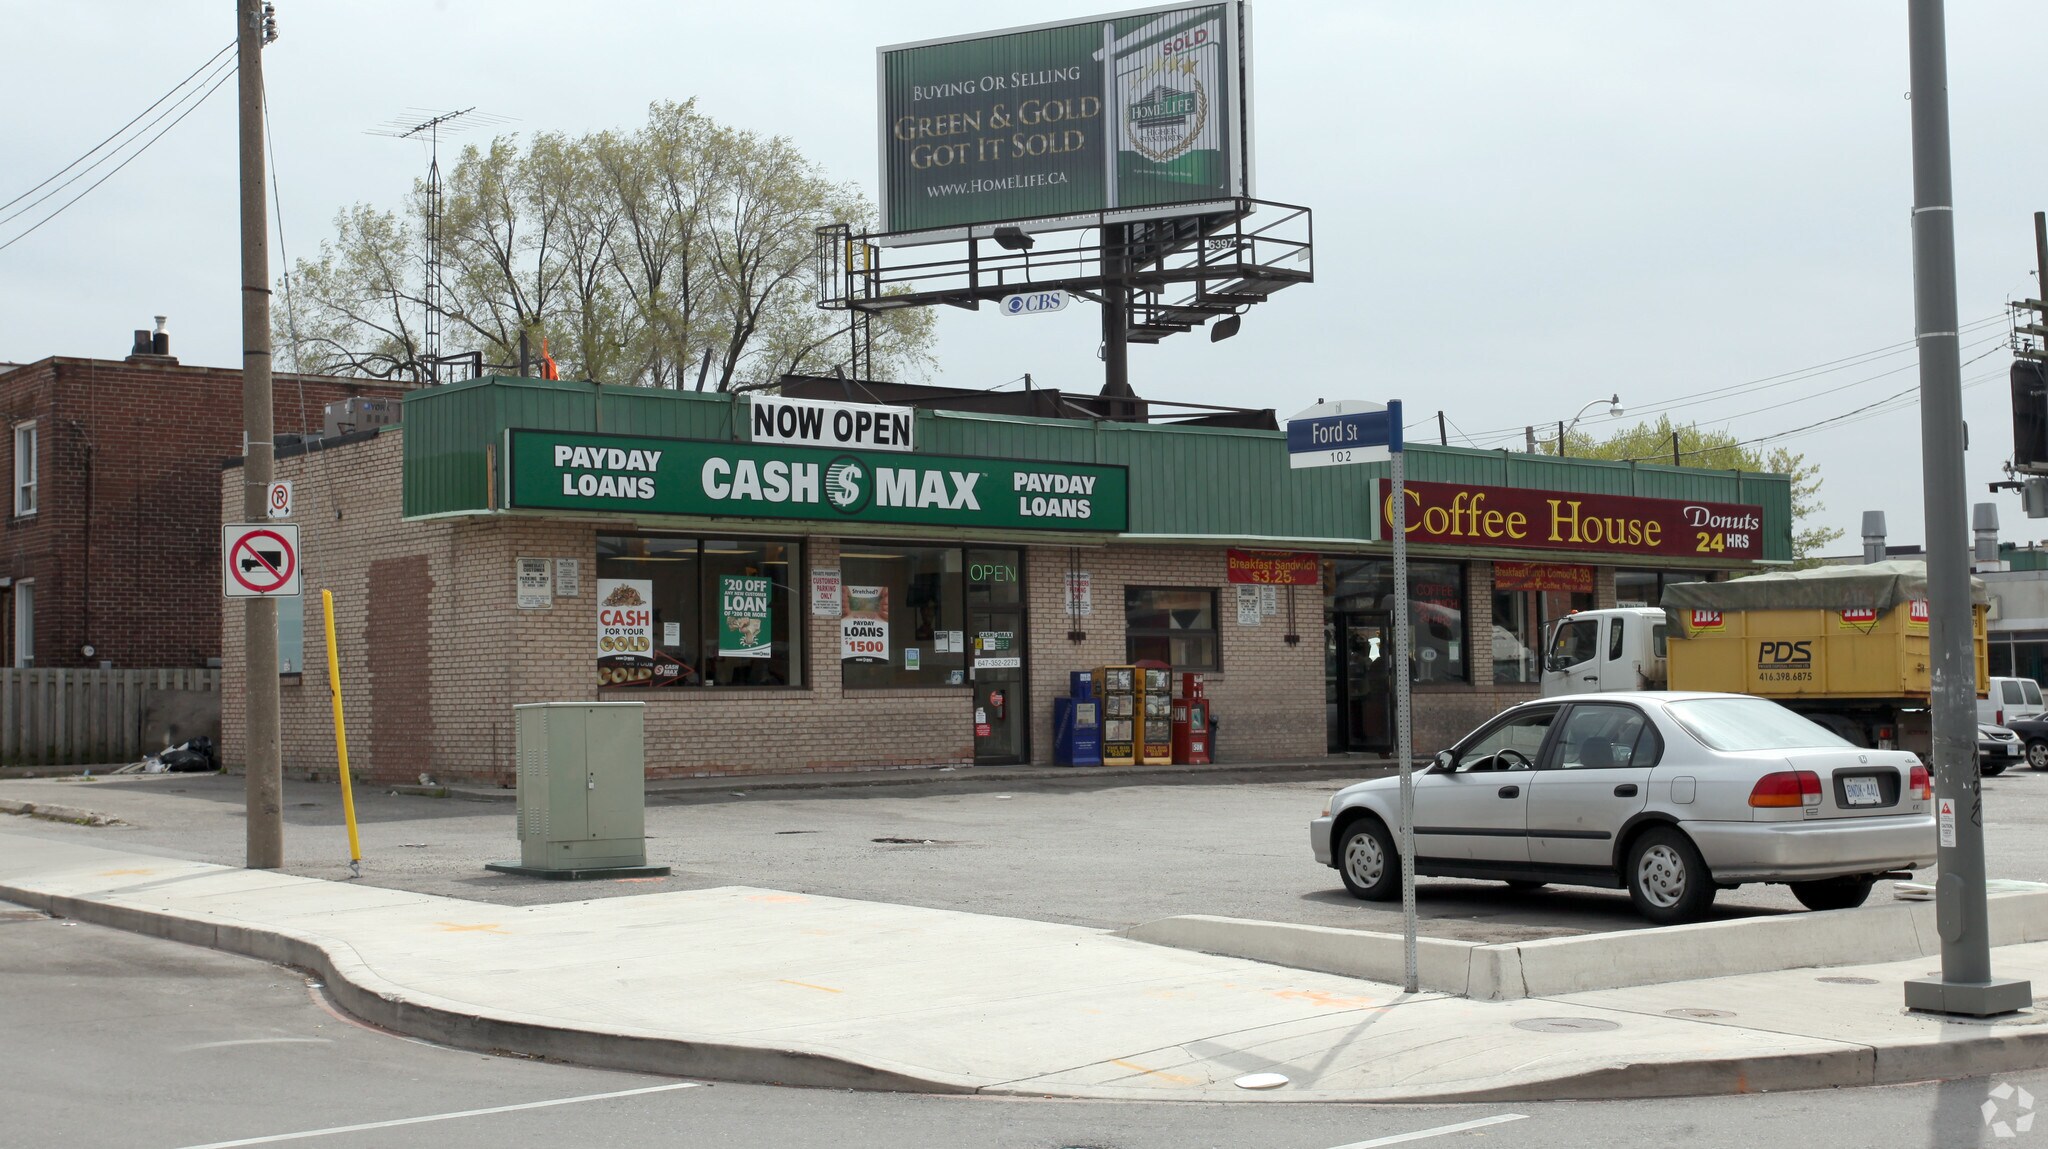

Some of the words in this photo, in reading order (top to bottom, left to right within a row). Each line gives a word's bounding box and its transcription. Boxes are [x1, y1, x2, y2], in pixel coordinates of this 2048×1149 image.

[1163, 29, 1208, 55] SOLD
[894, 110, 981, 141] GREEN
[990, 104, 1014, 129] &
[1018, 96, 1101, 125] GOLD
[1131, 98, 1193, 120] HOMELIFE
[910, 142, 971, 169] GOT
[977, 137, 1005, 162] IT
[1012, 130, 1085, 158] SOLD
[1208, 239, 1233, 249] 6397
[1025, 293, 1061, 311] CBS
[754, 403, 824, 440] NOW
[833, 409, 910, 446] OPEN
[1312, 421, 1343, 444] Ford
[1346, 424, 1358, 441] St
[554, 445, 662, 472] PAYDAY
[1331, 451, 1351, 462] 102
[563, 474, 656, 499] LOANS
[701, 457, 819, 503] CASH
[876, 467, 981, 511] MAX
[1013, 472, 1096, 495] PAYDAY
[1020, 496, 1091, 519] LOANS
[1384, 489, 1527, 539] Coffee
[1547, 499, 1662, 547] House
[1683, 506, 1759, 530] Donuts
[1696, 531, 1725, 553] 24
[1726, 533, 1749, 549] HRS
[970, 564, 1017, 582] OPEN
[1229, 557, 1273, 570] Breakfast
[1275, 560, 1316, 571] Sandwich
[724, 579, 743, 591] $20
[745, 580, 767, 592] OFF
[724, 596, 767, 612] LOAN
[600, 609, 650, 627] CASH
[844, 627, 884, 637] LOANS
[600, 636, 650, 652] GOLD
[1759, 641, 1812, 662] PDS
[977, 659, 1018, 667] 647-352-2273
[597, 667, 652, 685] GOLD
[1759, 672, 1812, 681] 416.398.6875
